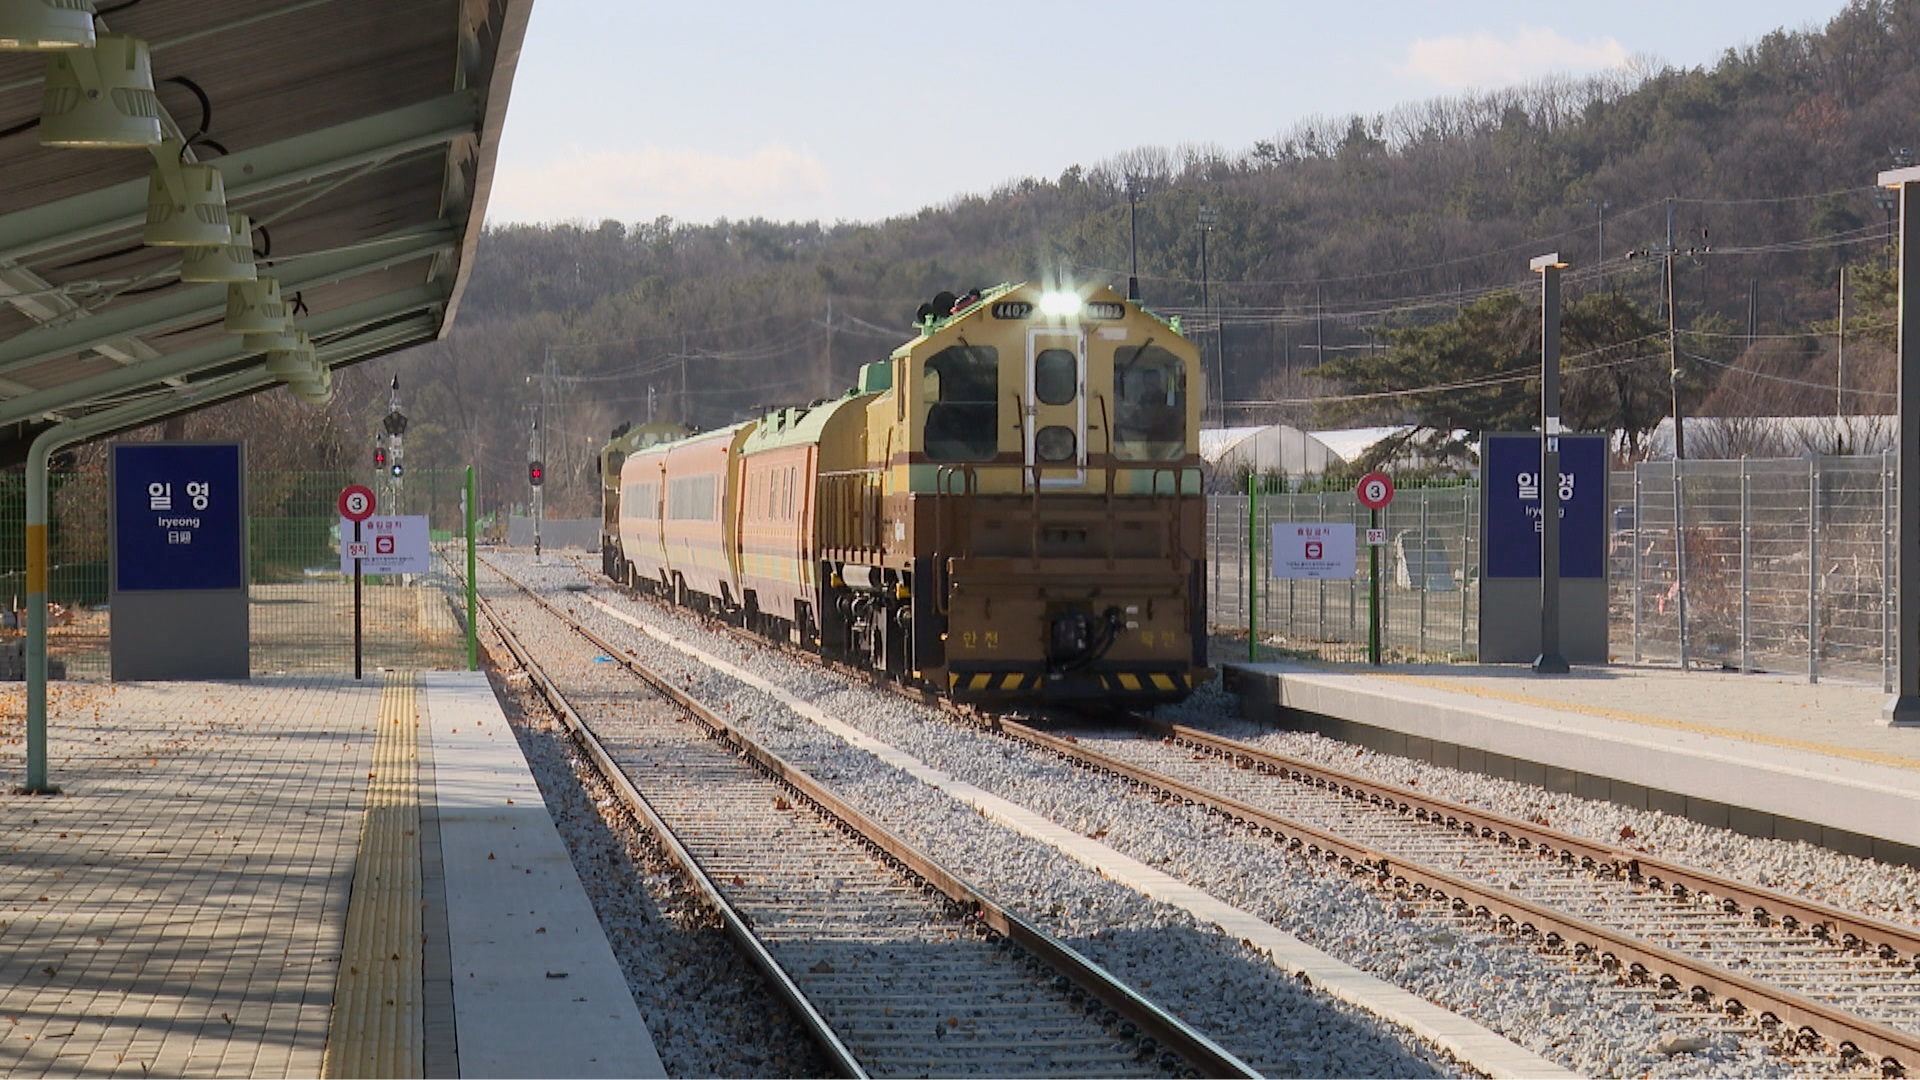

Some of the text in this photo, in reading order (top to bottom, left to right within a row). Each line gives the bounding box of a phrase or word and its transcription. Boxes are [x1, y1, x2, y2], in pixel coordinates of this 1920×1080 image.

[997, 304, 1028, 316] 4402
[1370, 485, 1381, 498] 3
[351, 497, 363, 510] 3
[158, 516, 201, 529] Iryeong
[1368, 531, 1385, 542] 정지
[349, 545, 367, 556] 정지
